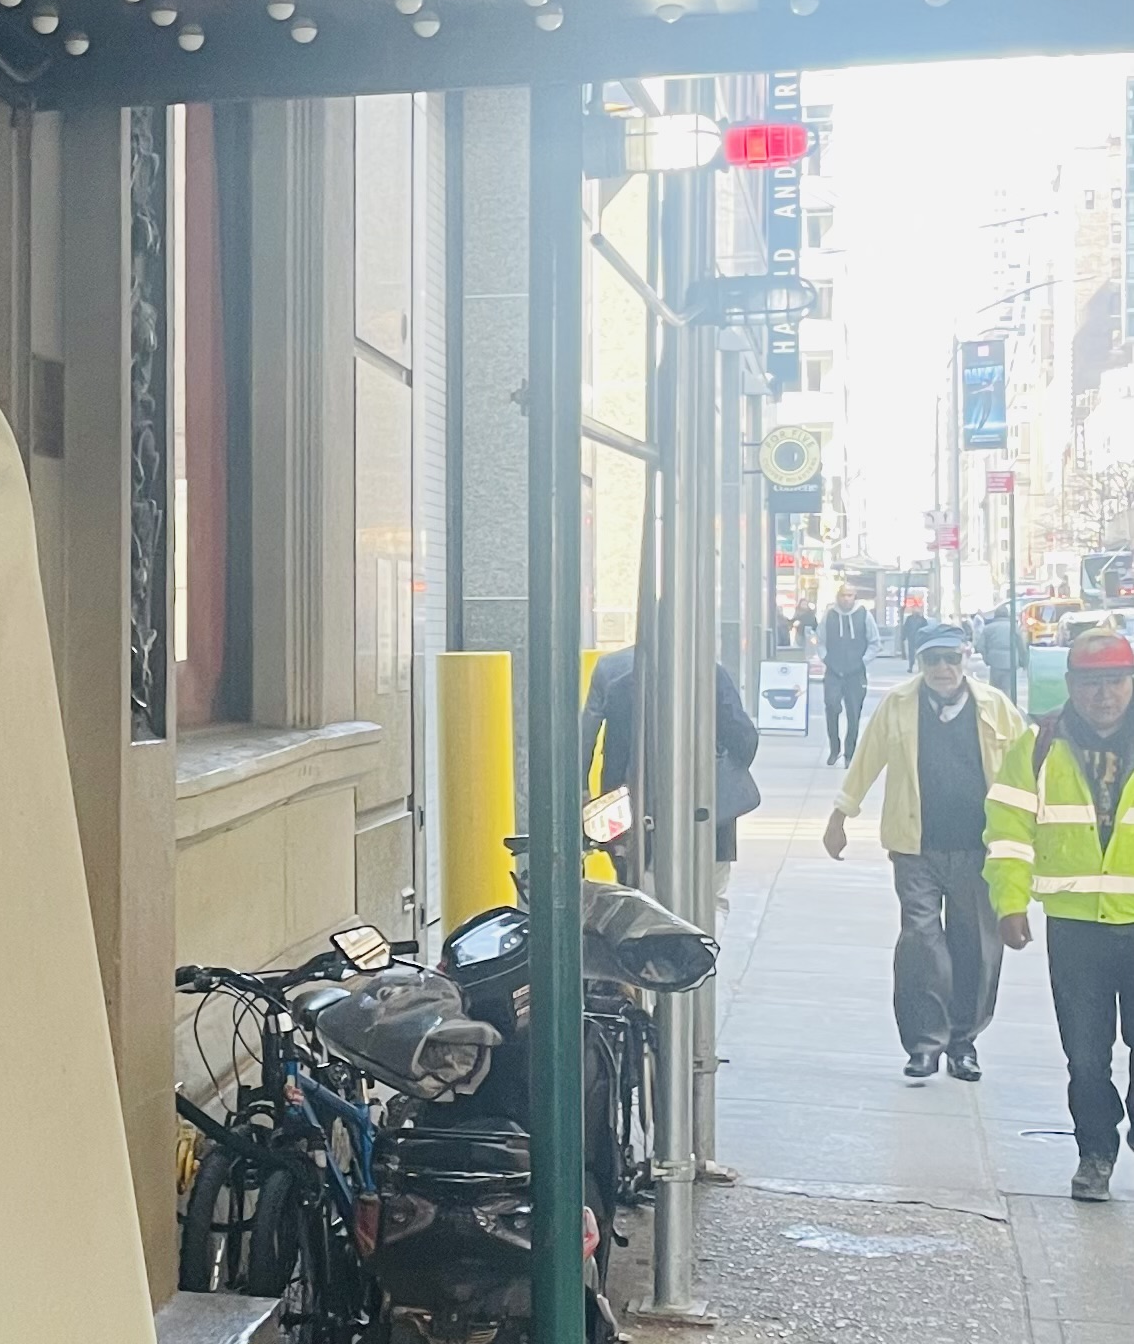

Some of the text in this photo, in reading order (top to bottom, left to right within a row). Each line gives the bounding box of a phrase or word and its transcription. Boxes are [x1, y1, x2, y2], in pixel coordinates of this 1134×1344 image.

[773, 165, 797, 219] AND
[773, 249, 797, 354] HALD
[791, 429, 816, 449] FIVE
